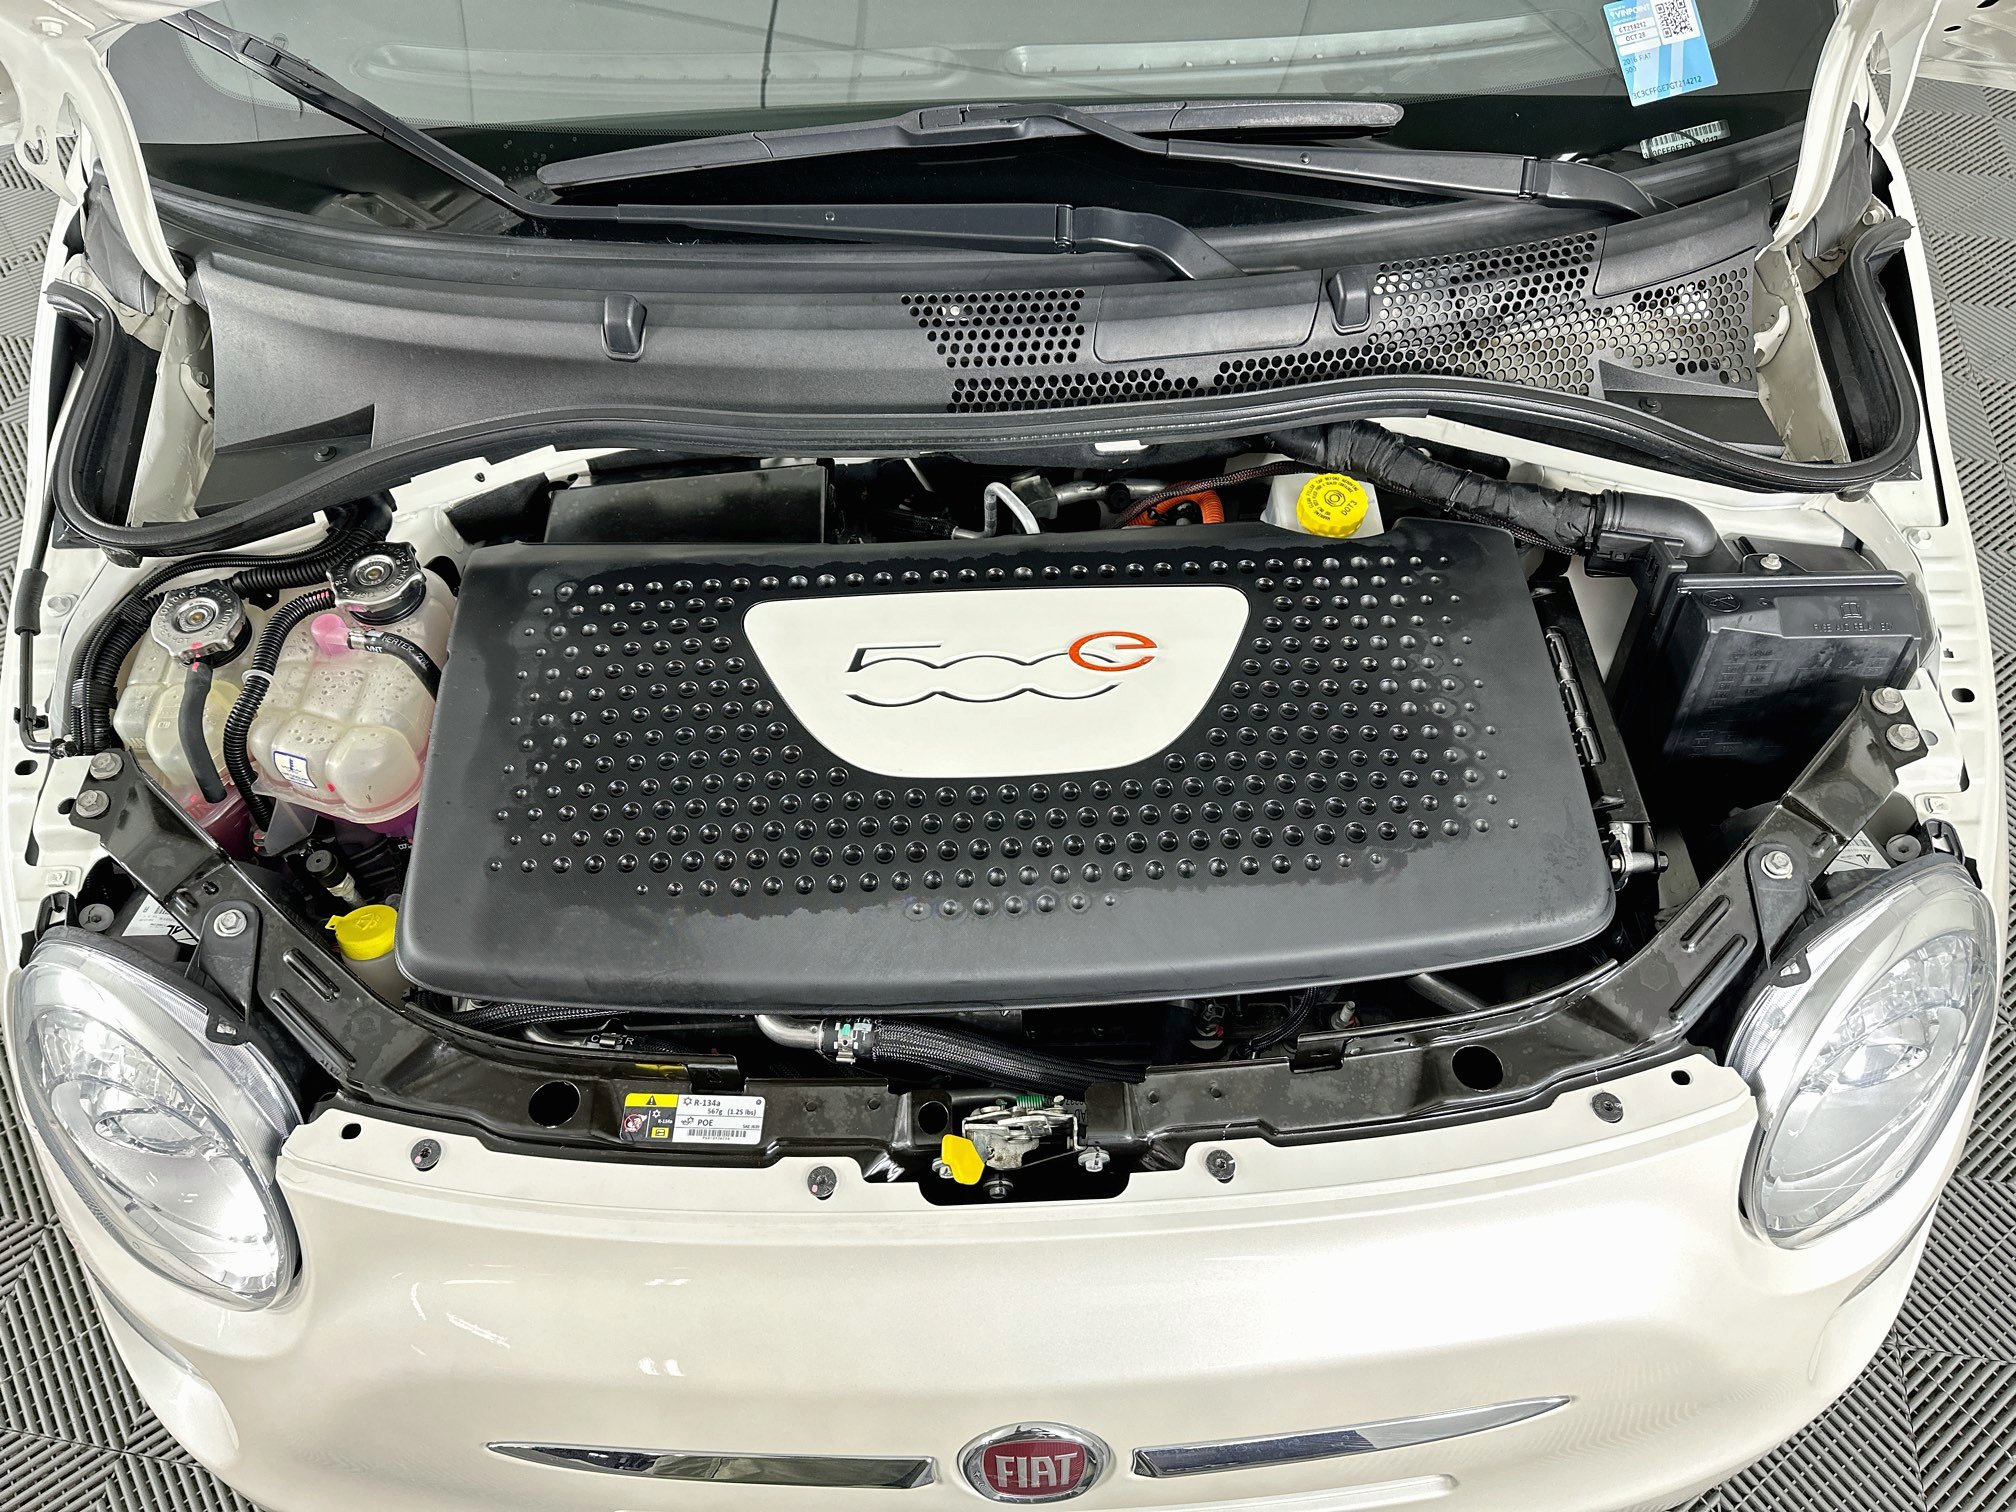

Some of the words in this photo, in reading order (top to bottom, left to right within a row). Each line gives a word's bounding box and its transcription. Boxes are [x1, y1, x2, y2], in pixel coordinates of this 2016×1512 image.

[1625, 34, 1637, 42] OCT
[1623, 57, 1638, 66] 2016
[1639, 53, 1652, 61] FIAT
[382, 635, 415, 653] HEATER
[694, 1099, 720, 1107] R-134a
[707, 1108, 723, 1116] 567g
[727, 1108, 743, 1116] (1.25
[995, 1452, 1078, 1488] FIAT
